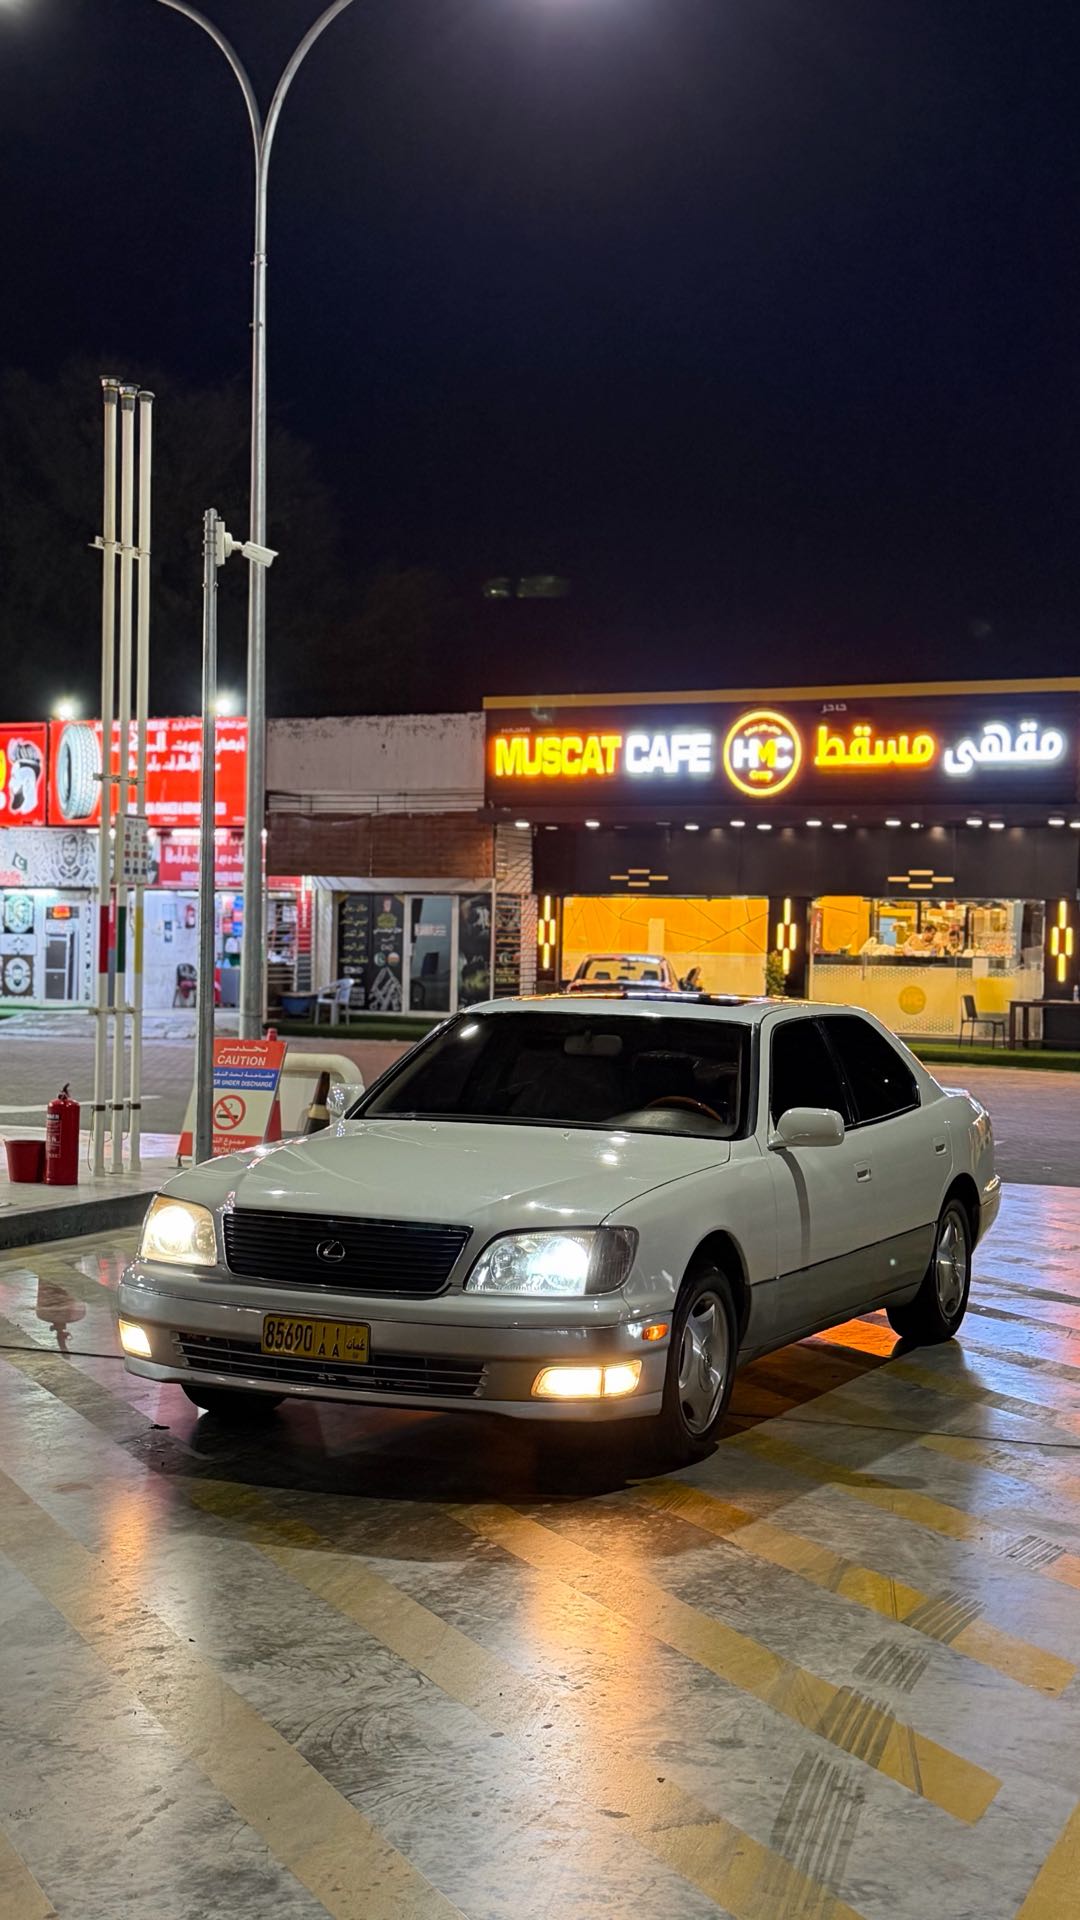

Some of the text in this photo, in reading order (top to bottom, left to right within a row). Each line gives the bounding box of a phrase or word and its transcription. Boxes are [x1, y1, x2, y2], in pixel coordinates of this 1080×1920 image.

[495, 731, 712, 777] MUSCAT CAFE
[732, 737, 793, 769] HMC
[814, 721, 1064, 773] مقهى مسقط
[218, 1055, 266, 1066] CAUTION
[220, 1045, 269, 1053] تحذير
[241, 1080, 273, 1088] DISCHARGE
[266, 1321, 312, 1351] 85690
